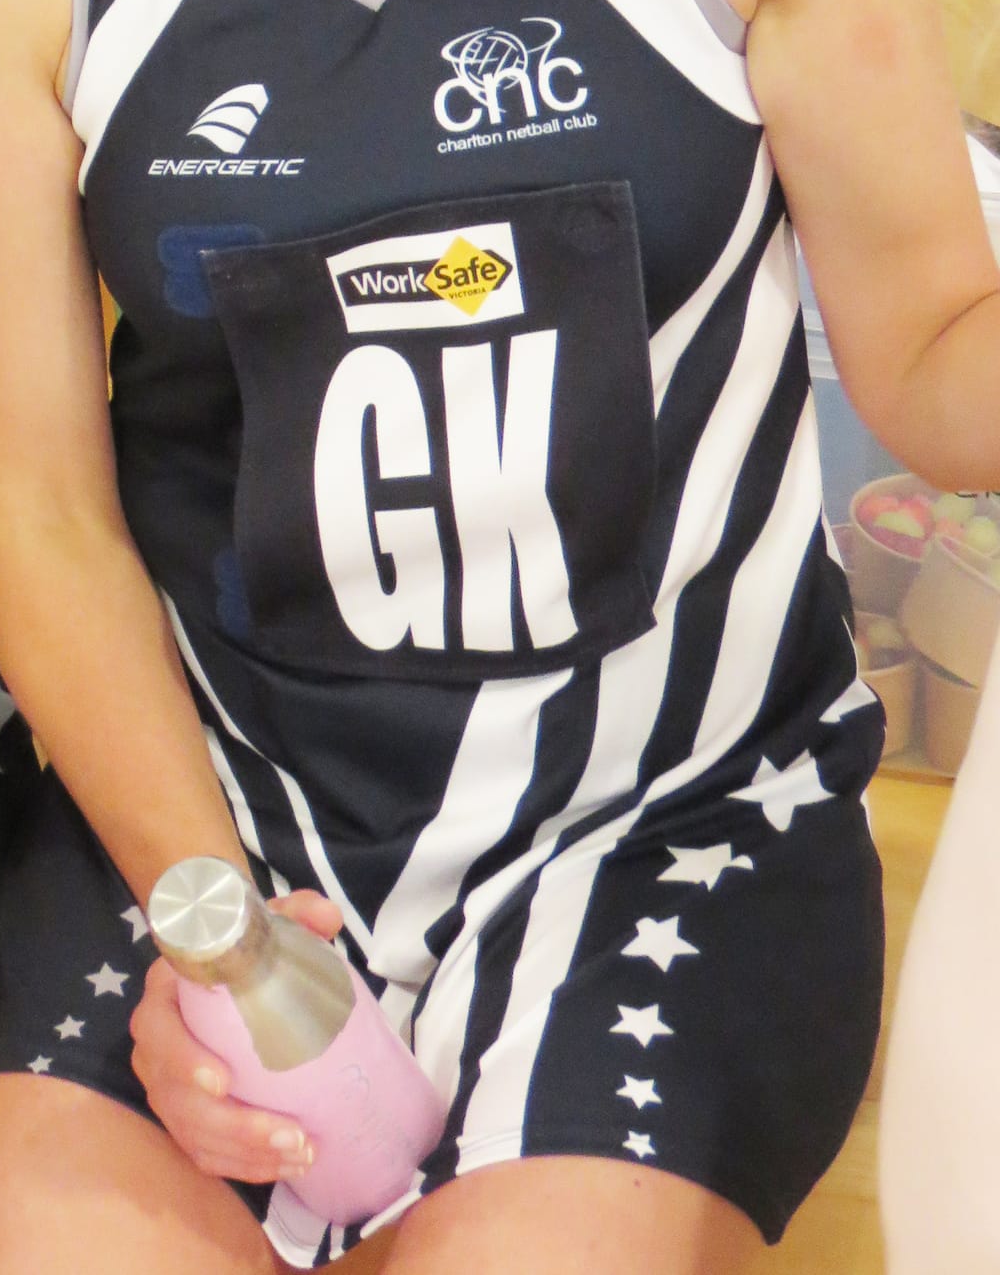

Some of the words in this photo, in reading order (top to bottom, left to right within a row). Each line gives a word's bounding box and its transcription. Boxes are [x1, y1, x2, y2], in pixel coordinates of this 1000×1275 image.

[434, 57, 588, 132] cnc
[437, 132, 503, 154] charlton
[506, 119, 561, 142] netball
[563, 113, 598, 130] club
[147, 158, 305, 176] ENERGETIC
[448, 286, 487, 300] VICTORIA
[313, 328, 580, 652] GK
